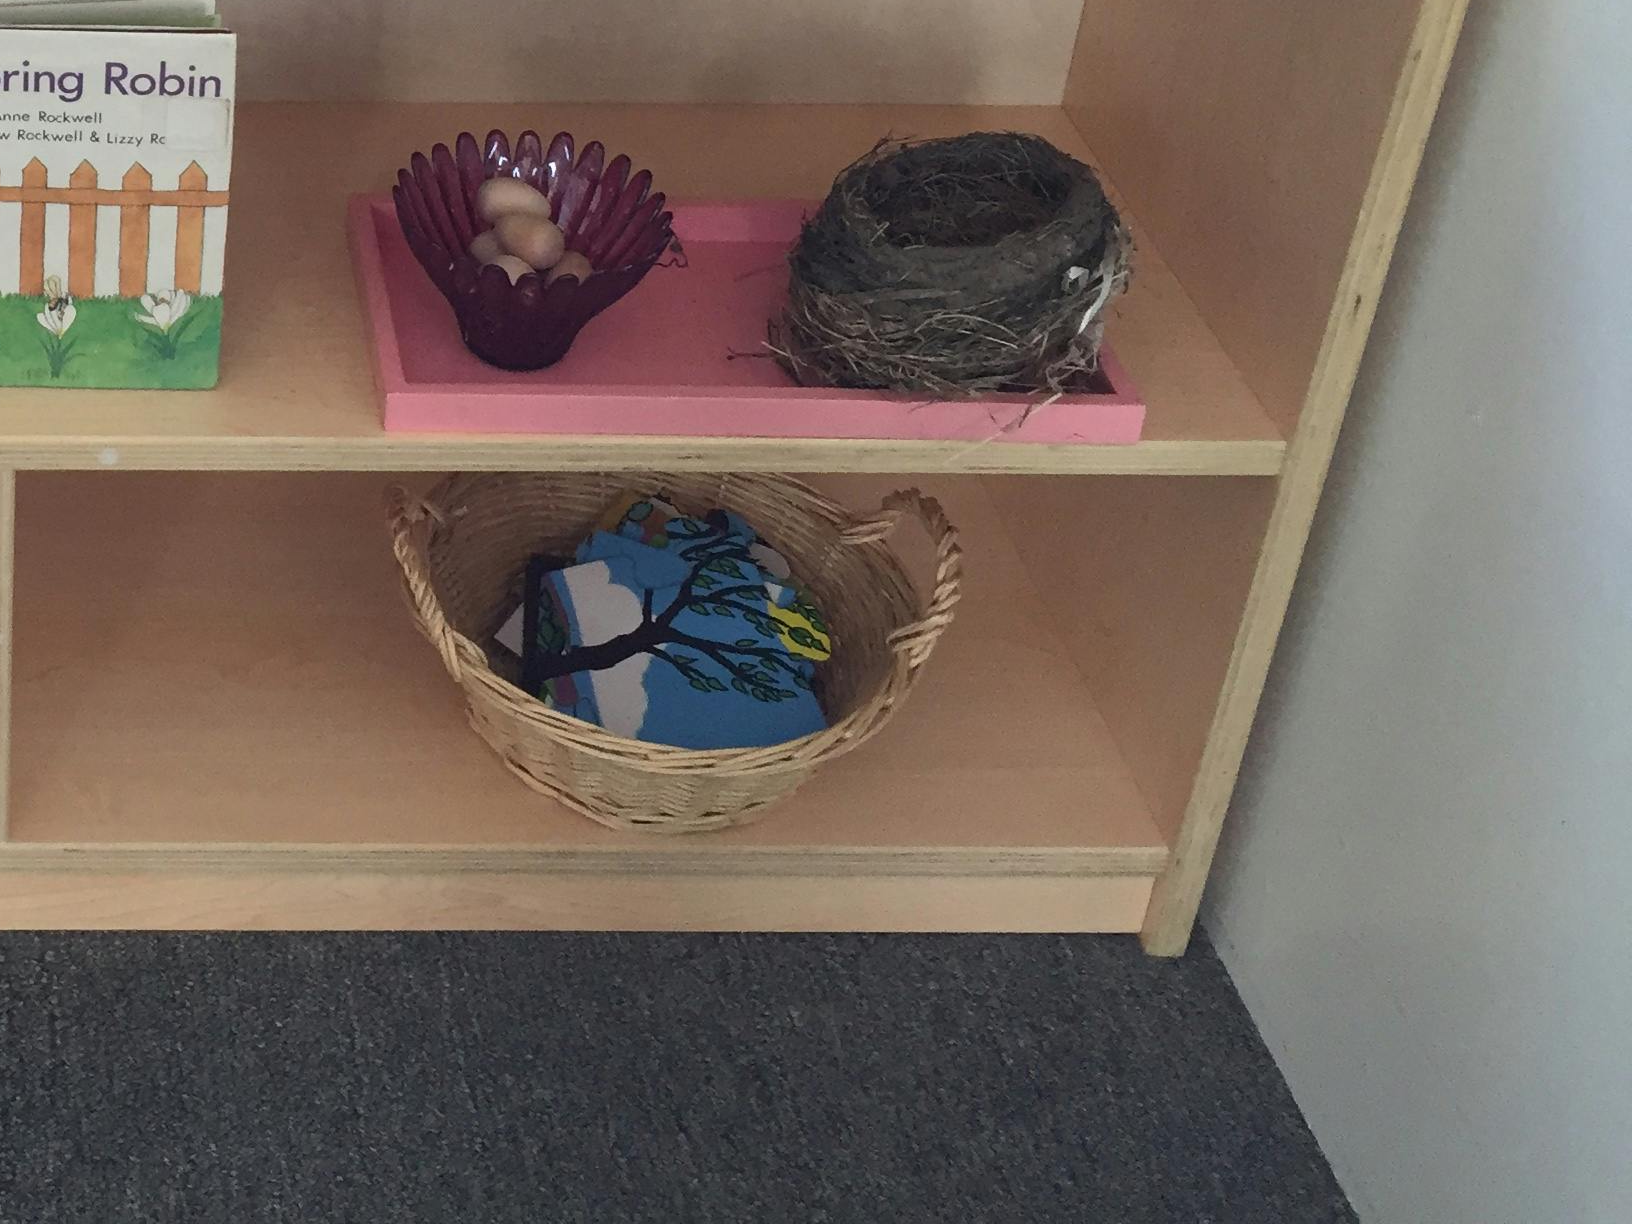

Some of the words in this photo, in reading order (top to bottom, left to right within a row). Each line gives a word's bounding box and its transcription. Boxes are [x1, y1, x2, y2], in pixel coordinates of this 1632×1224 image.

[104, 62, 222, 98] Robin
[39, 111, 102, 124] Rockwell
[18, 130, 82, 142] Rockwell
[90, 132, 99, 143] &
[107, 133, 143, 147] Lizzy
